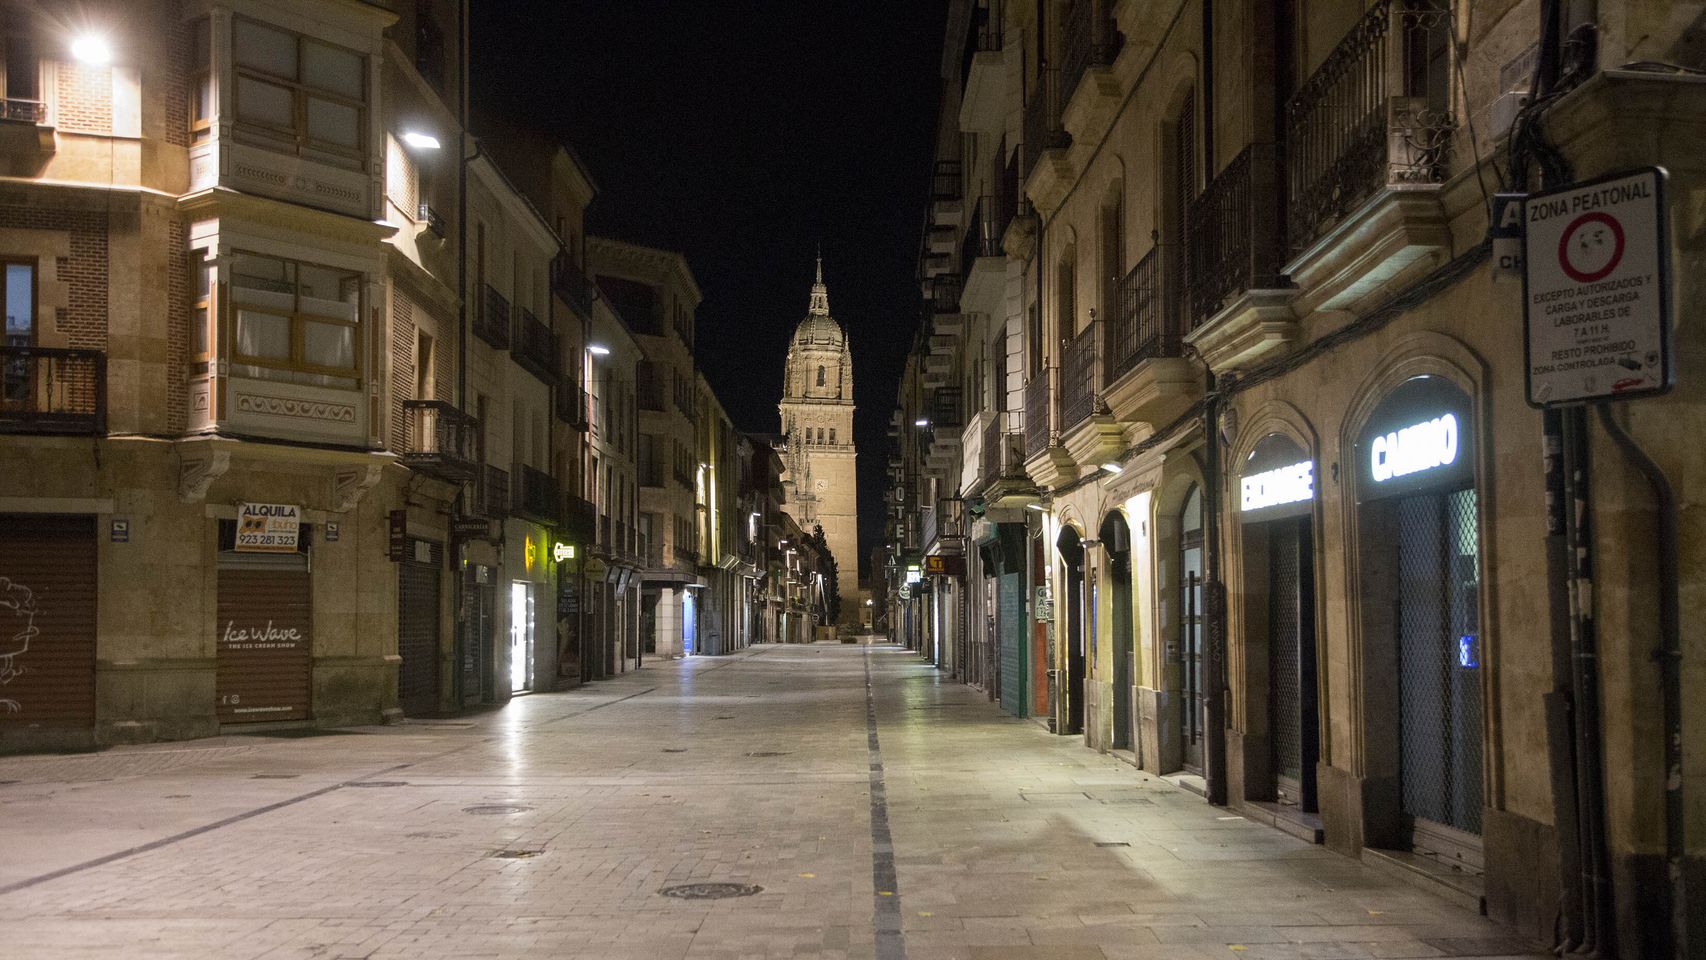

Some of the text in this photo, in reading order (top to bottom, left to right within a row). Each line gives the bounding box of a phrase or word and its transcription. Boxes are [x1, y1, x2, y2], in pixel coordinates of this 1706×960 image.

[1530, 182, 1651, 222] ZONA PEATONAL
[1533, 274, 1652, 304] EXCEPTO AUTORIZADOS Y
[1545, 291, 1640, 315] CARGA Y DESCARGA
[1554, 306, 1631, 327] LABORABLES DE
[1581, 327, 1588, 336] A
[1590, 325, 1599, 335] 11
[1551, 348, 1583, 361] RESTO
[1584, 340, 1636, 356] PROHIBIDO
[1532, 357, 1616, 375] ZONA CONTROLADA
[243, 505, 297, 517] ALQUILA
[239, 534, 296, 545] 923 281 323
[223, 620, 302, 642] Ice Wave
